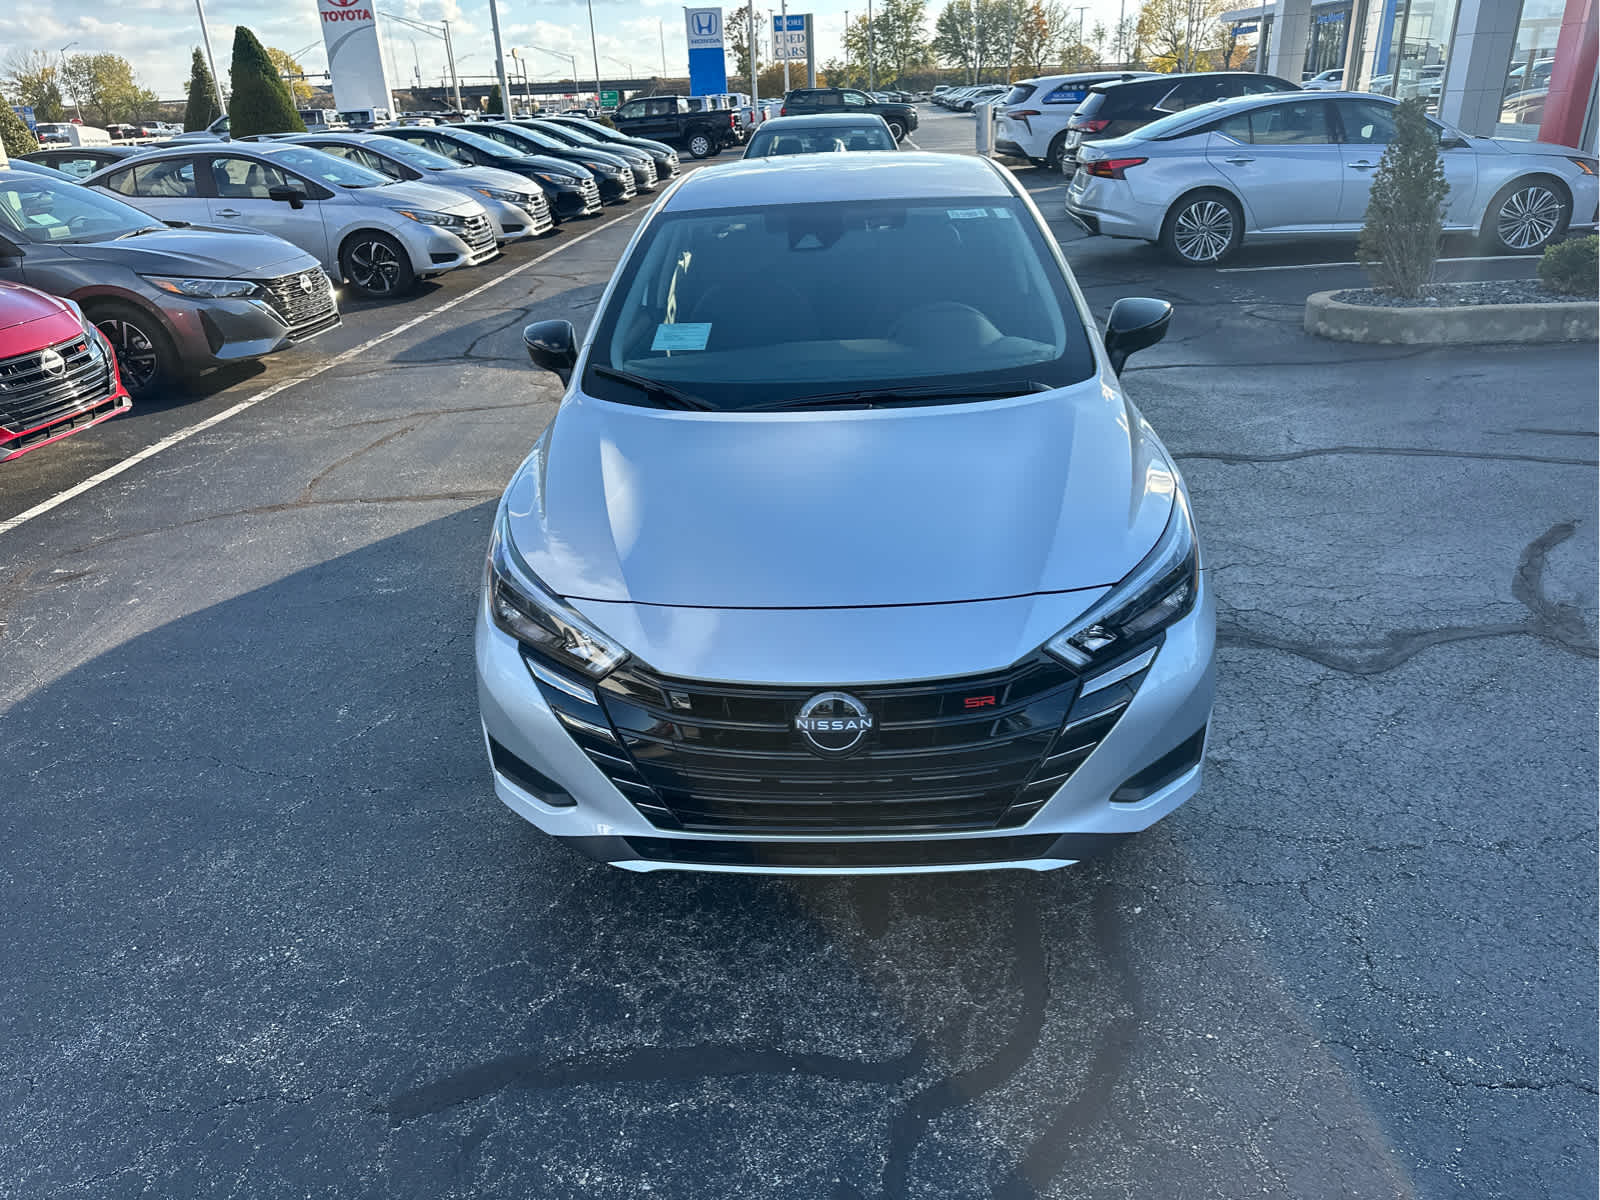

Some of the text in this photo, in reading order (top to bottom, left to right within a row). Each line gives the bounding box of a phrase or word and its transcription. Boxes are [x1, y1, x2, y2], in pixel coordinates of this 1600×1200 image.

[320, 9, 372, 22] TOYOTA
[775, 33, 805, 44] USED
[775, 47, 806, 57] CARS
[964, 695, 996, 708] SR
[796, 718, 873, 731] NISSAN
